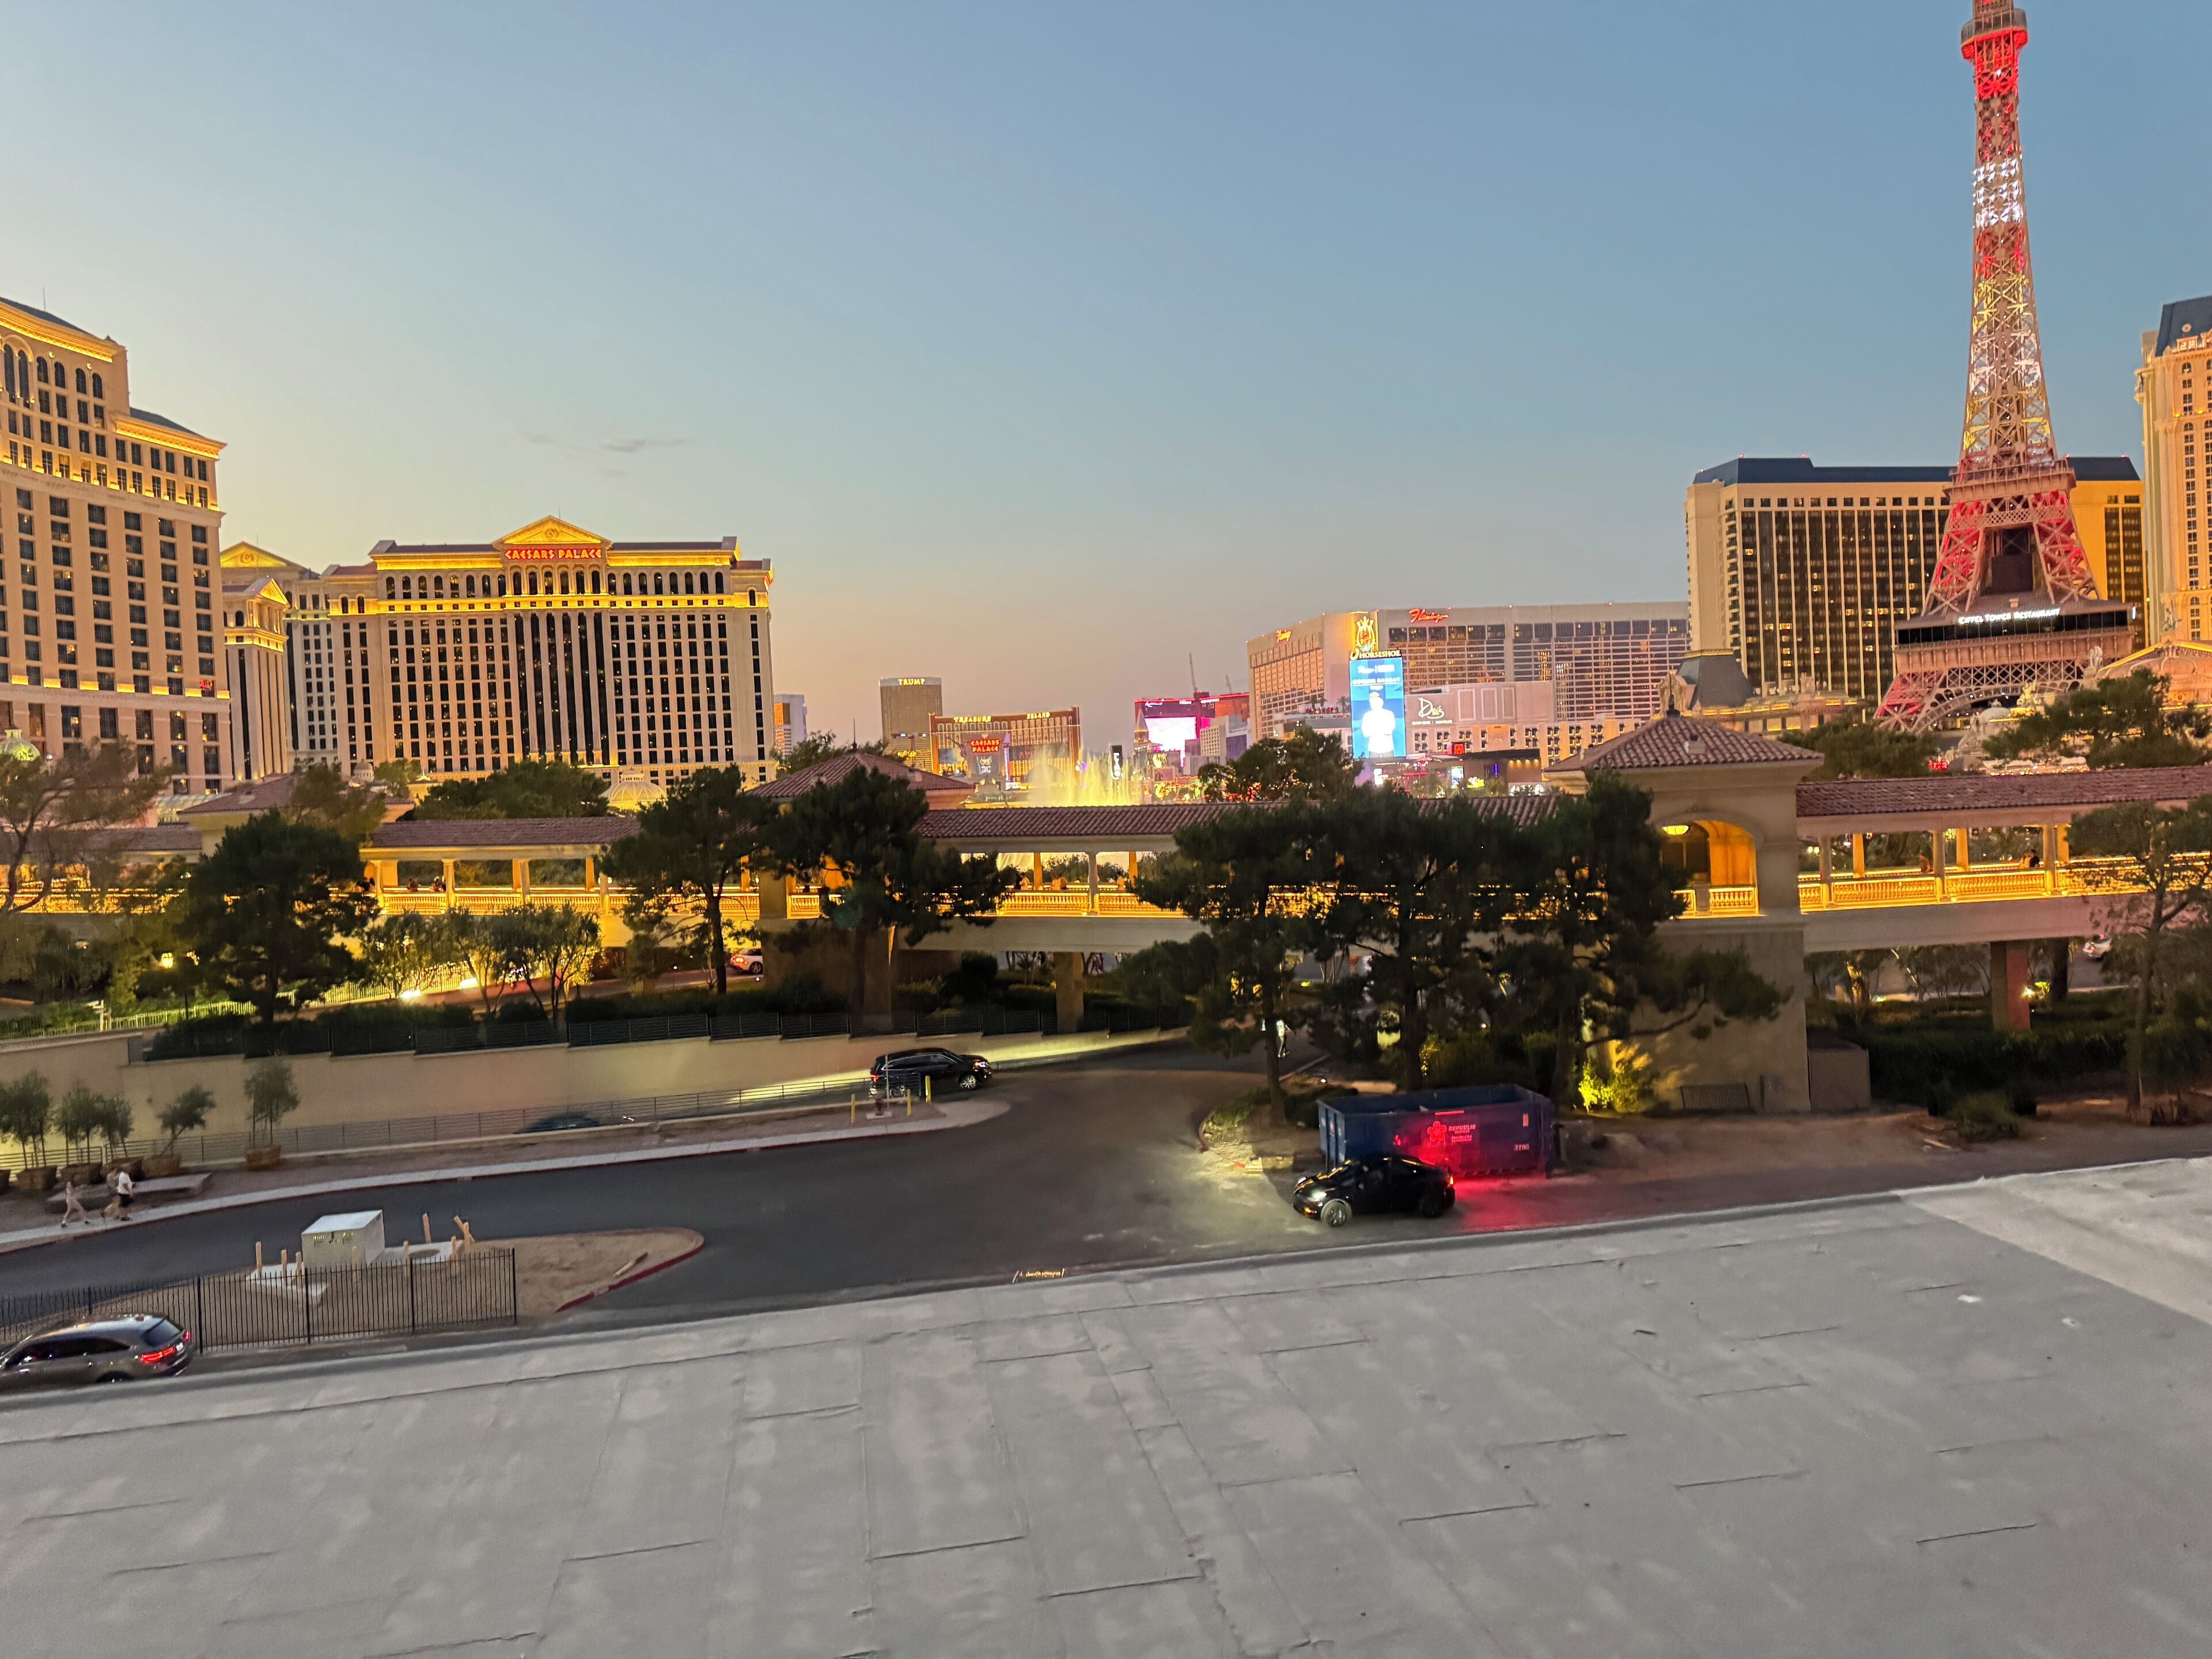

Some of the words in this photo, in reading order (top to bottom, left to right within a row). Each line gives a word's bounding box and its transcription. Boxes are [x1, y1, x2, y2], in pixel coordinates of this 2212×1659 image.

[505, 549, 555, 560] CAESARS
[558, 549, 601, 559] PALACE
[1409, 608, 1449, 623] Flamingo
[1984, 612, 2011, 622] TOWER
[2013, 607, 2061, 619] RESTAURANT
[1359, 650, 1402, 659] HORSESHOE
